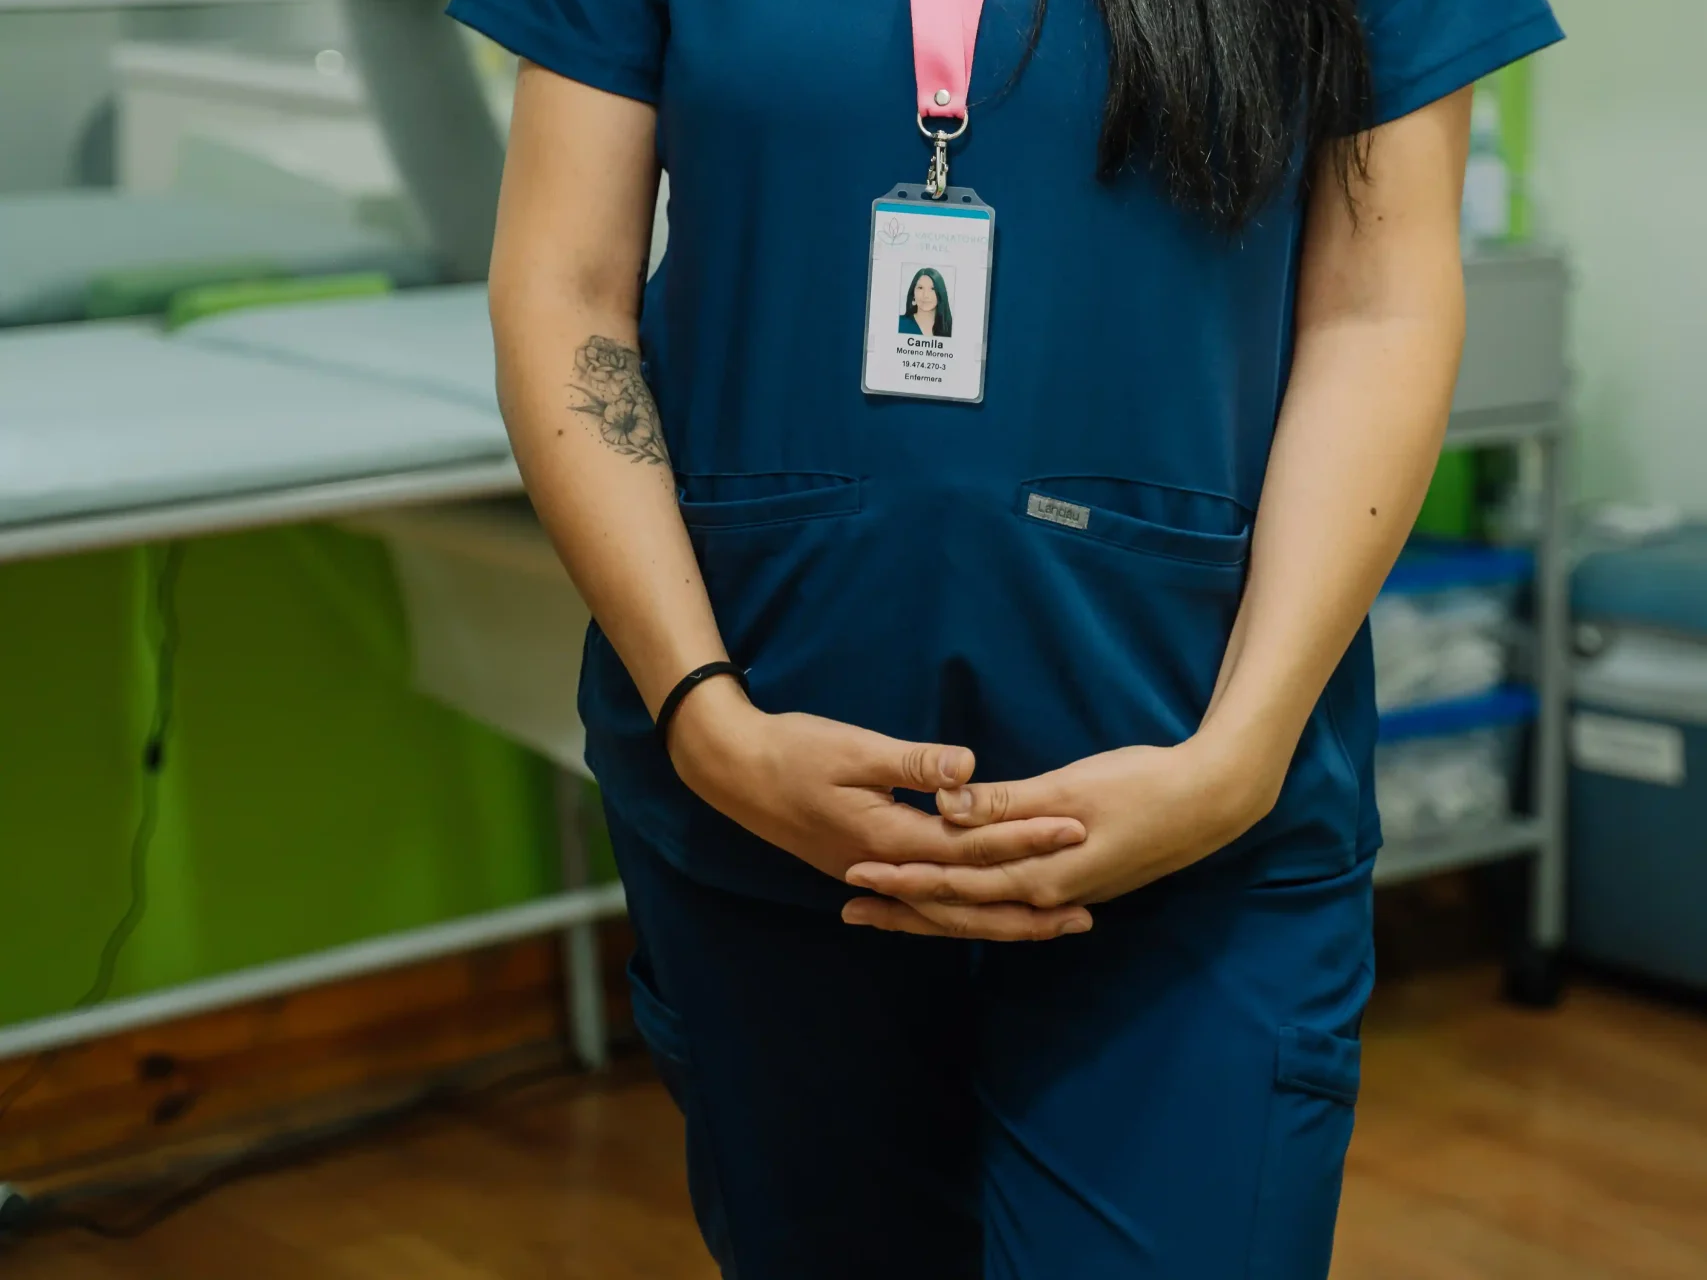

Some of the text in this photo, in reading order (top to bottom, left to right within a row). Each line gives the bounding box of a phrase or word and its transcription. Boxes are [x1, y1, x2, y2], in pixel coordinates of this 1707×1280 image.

[907, 337, 944, 349] Camila
[896, 347, 954, 359] Moreno Moreno
[902, 360, 947, 371] 19.474.270-3
[904, 373, 943, 383] Enfermera
[1037, 499, 1080, 522] Landau
